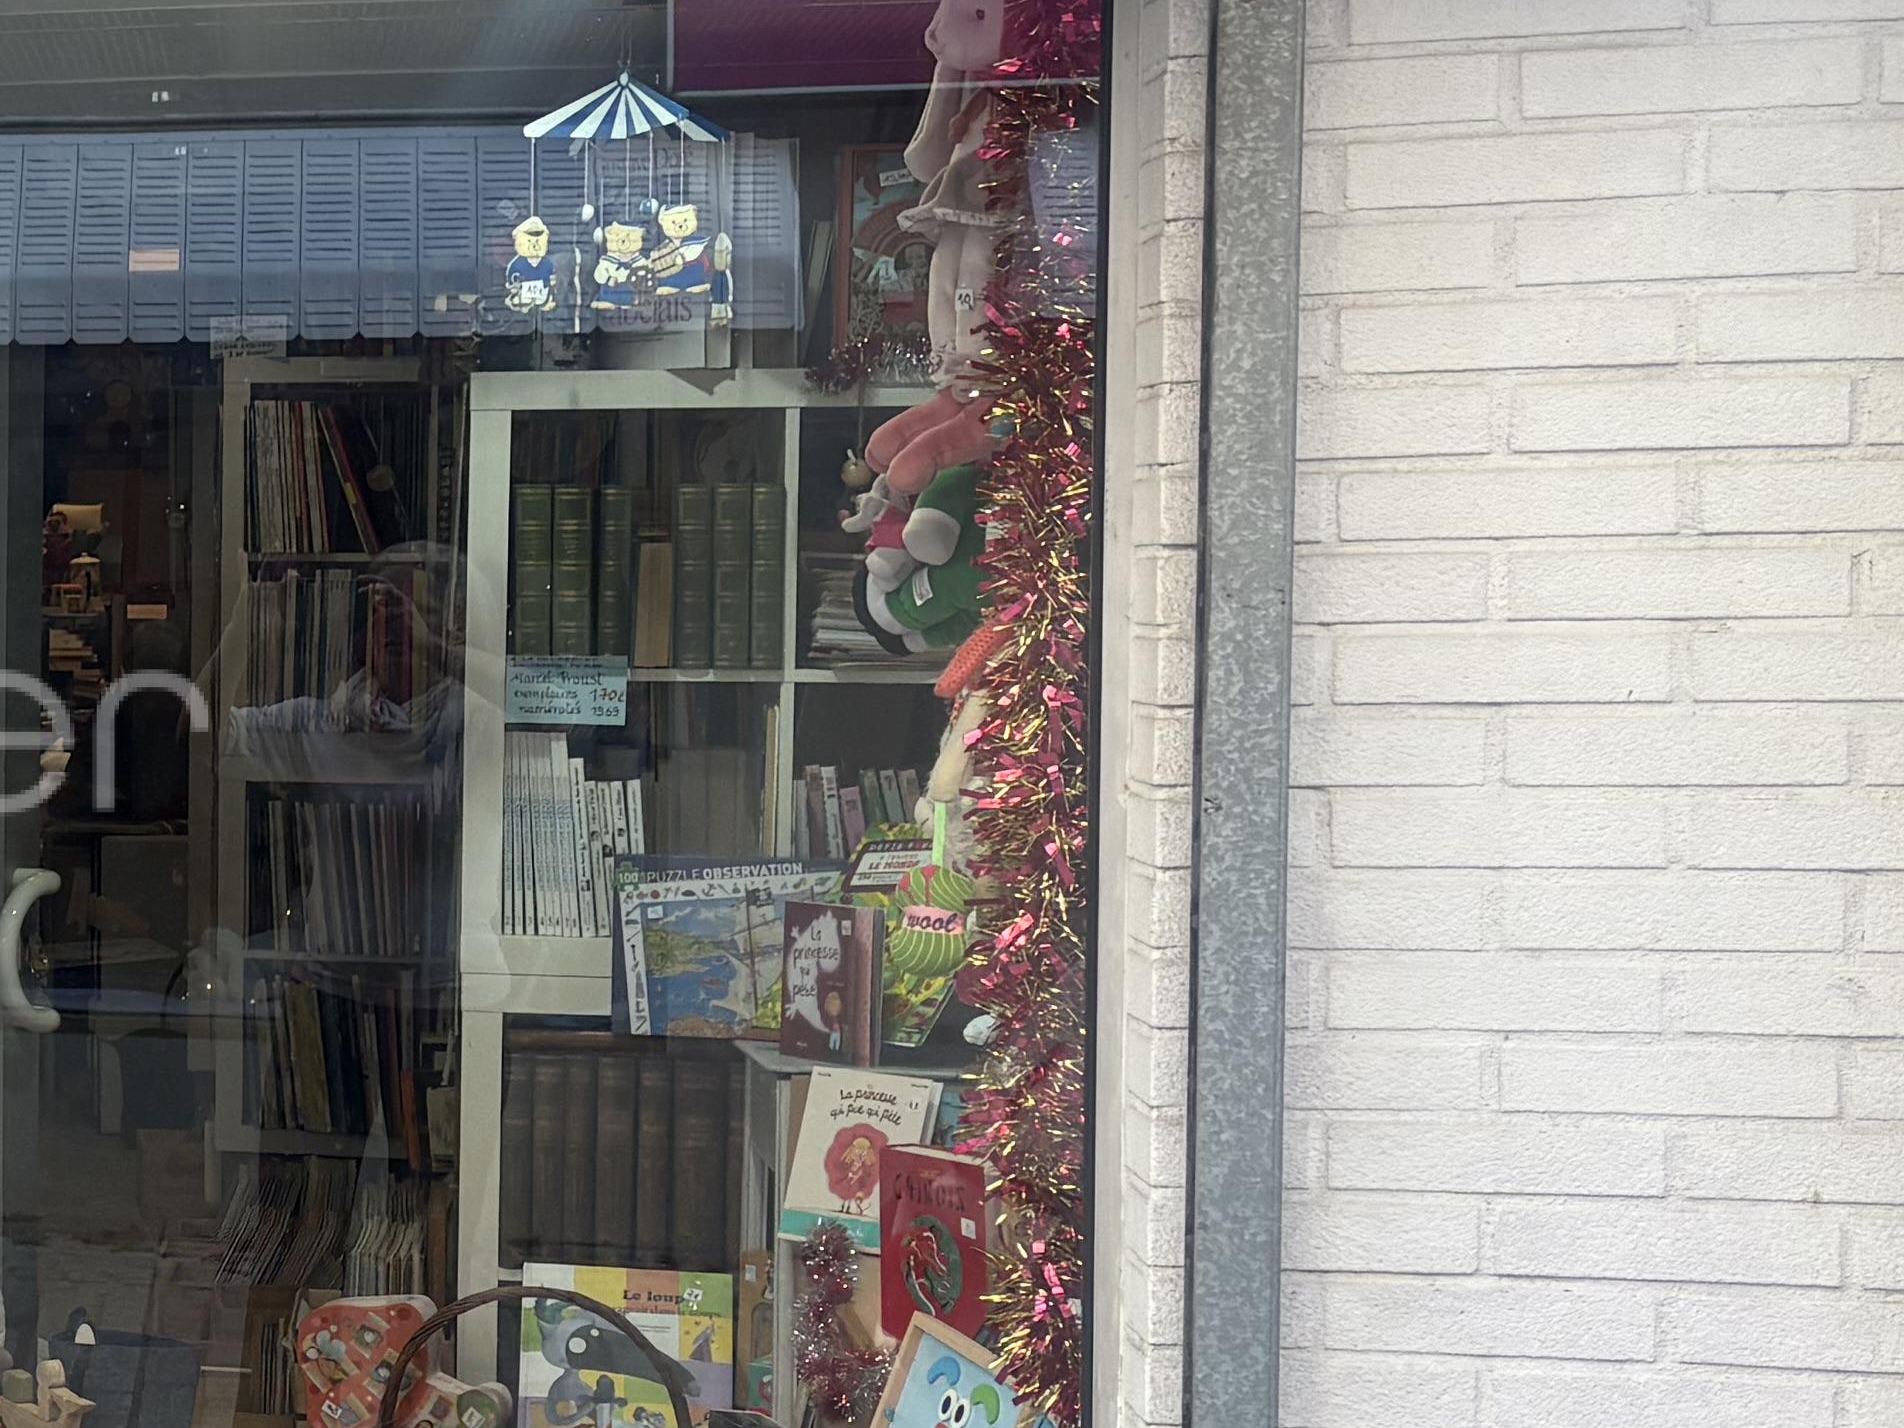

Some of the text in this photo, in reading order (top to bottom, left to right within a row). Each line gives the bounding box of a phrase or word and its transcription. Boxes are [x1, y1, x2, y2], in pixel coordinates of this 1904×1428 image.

[560, 671, 602, 685] Proust
[619, 874, 638, 883] 100
[703, 862, 803, 880] OBSERVATION
[907, 913, 959, 933] wool
[623, 1289, 685, 1304] Le loup
